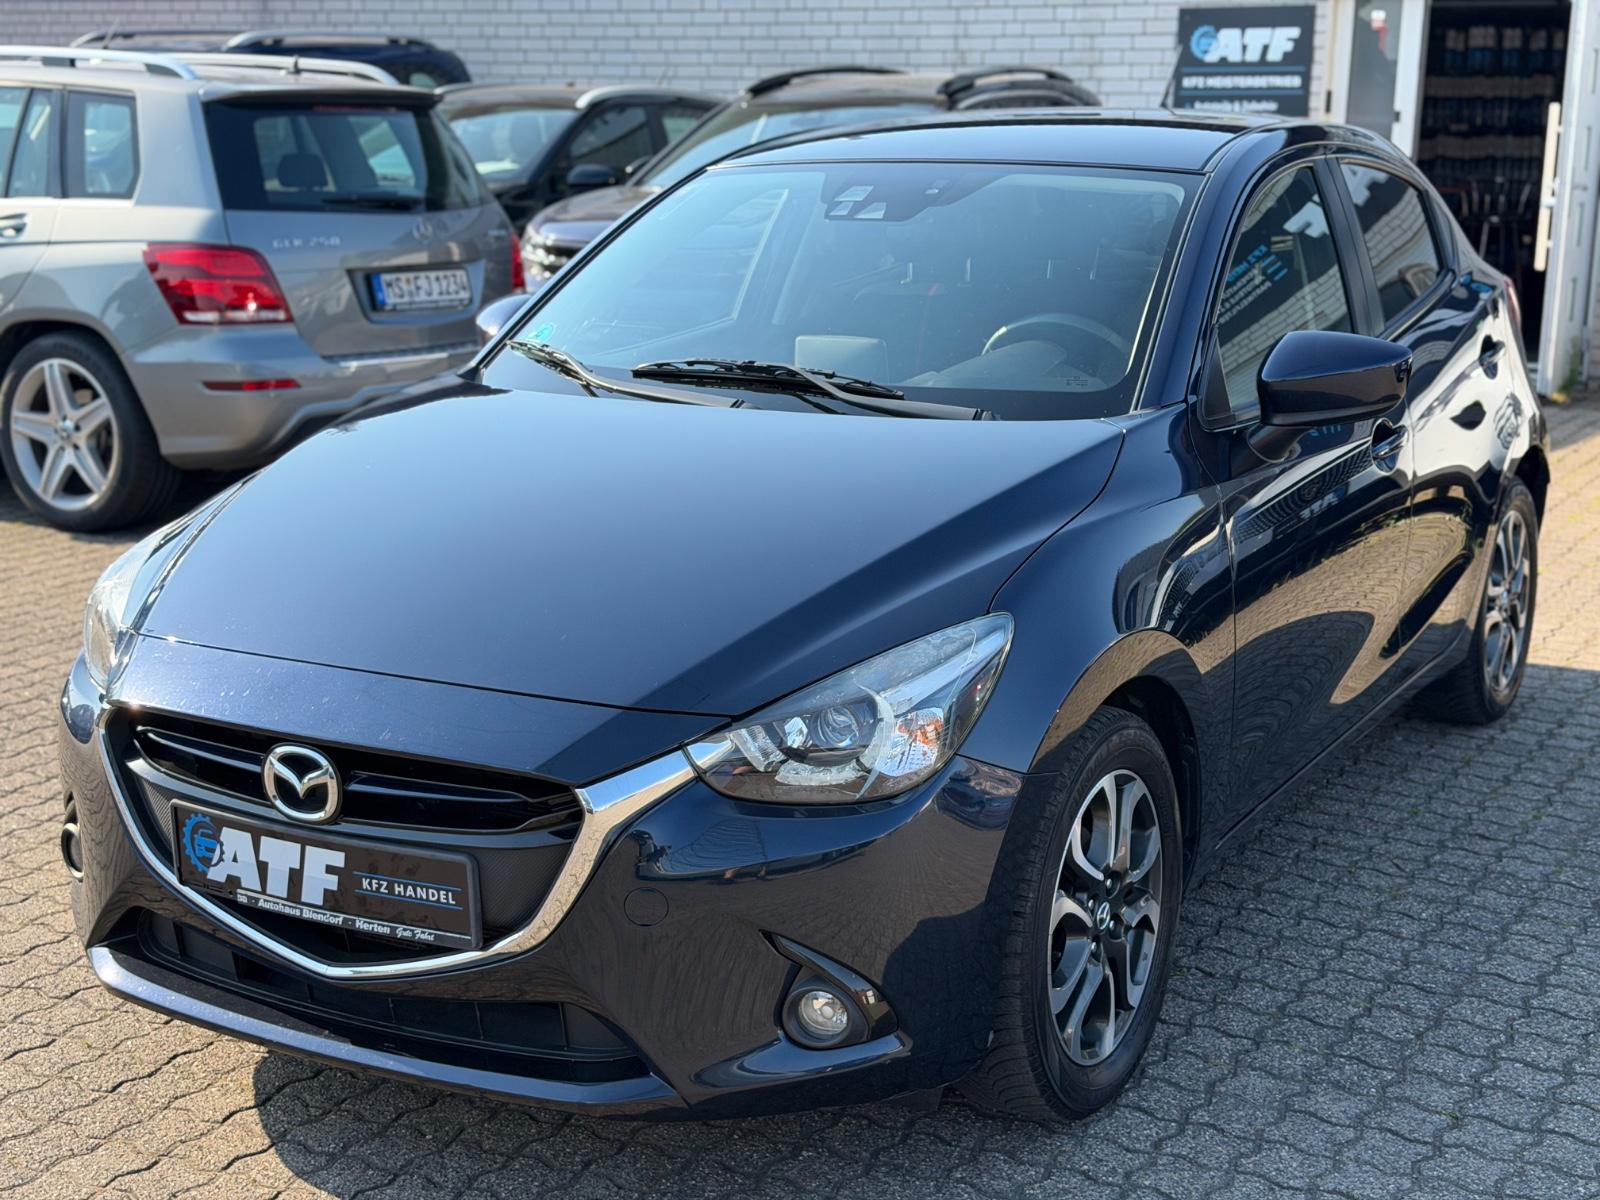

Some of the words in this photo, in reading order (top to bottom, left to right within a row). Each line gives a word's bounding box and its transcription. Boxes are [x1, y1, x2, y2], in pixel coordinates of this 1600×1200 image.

[1203, 26, 1301, 63] ATF
[385, 276, 405, 300] MS
[435, 272, 467, 297] 1234
[206, 826, 346, 906] ATF
[362, 877, 389, 894] KFZ
[394, 883, 456, 904] HANDEL
[258, 898, 301, 916] Autohaus
[355, 918, 391, 935] Herten
